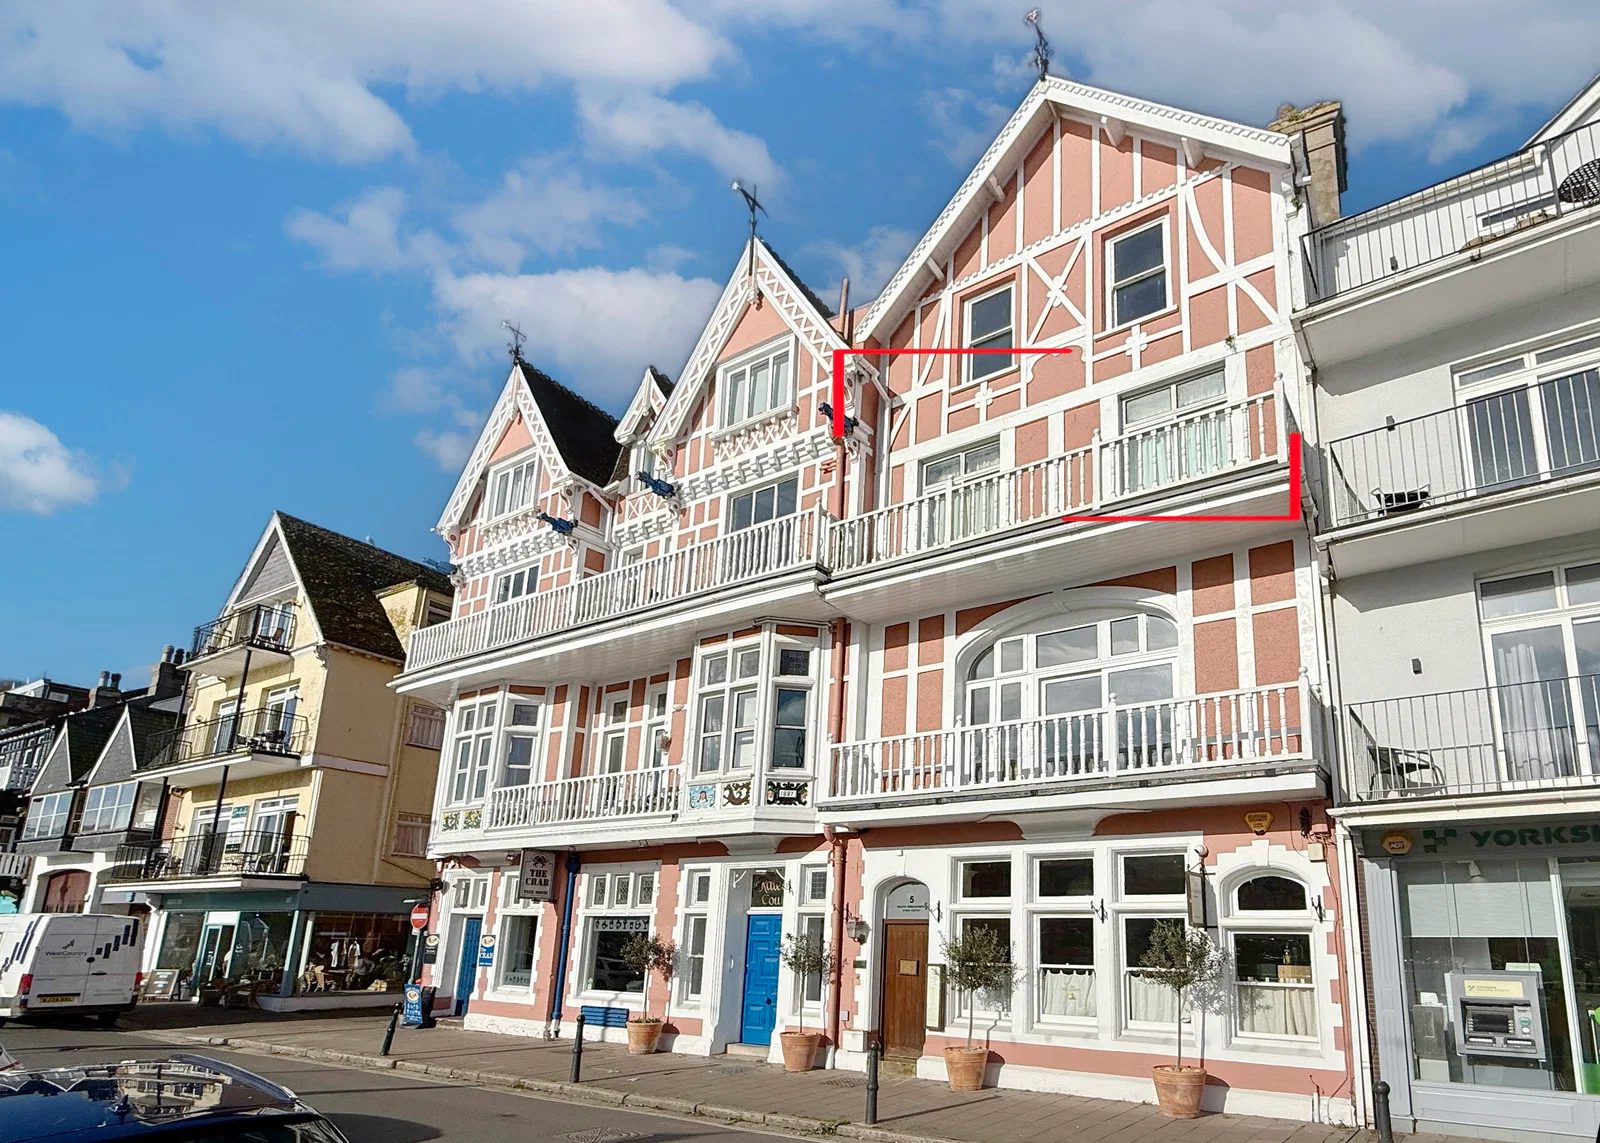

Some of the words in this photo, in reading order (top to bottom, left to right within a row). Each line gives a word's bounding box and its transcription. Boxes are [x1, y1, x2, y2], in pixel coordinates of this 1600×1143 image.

[530, 869, 547, 877] THE
[525, 877, 549, 886] CRAB
[761, 893, 781, 906] Cou
[909, 895, 915, 904] 5
